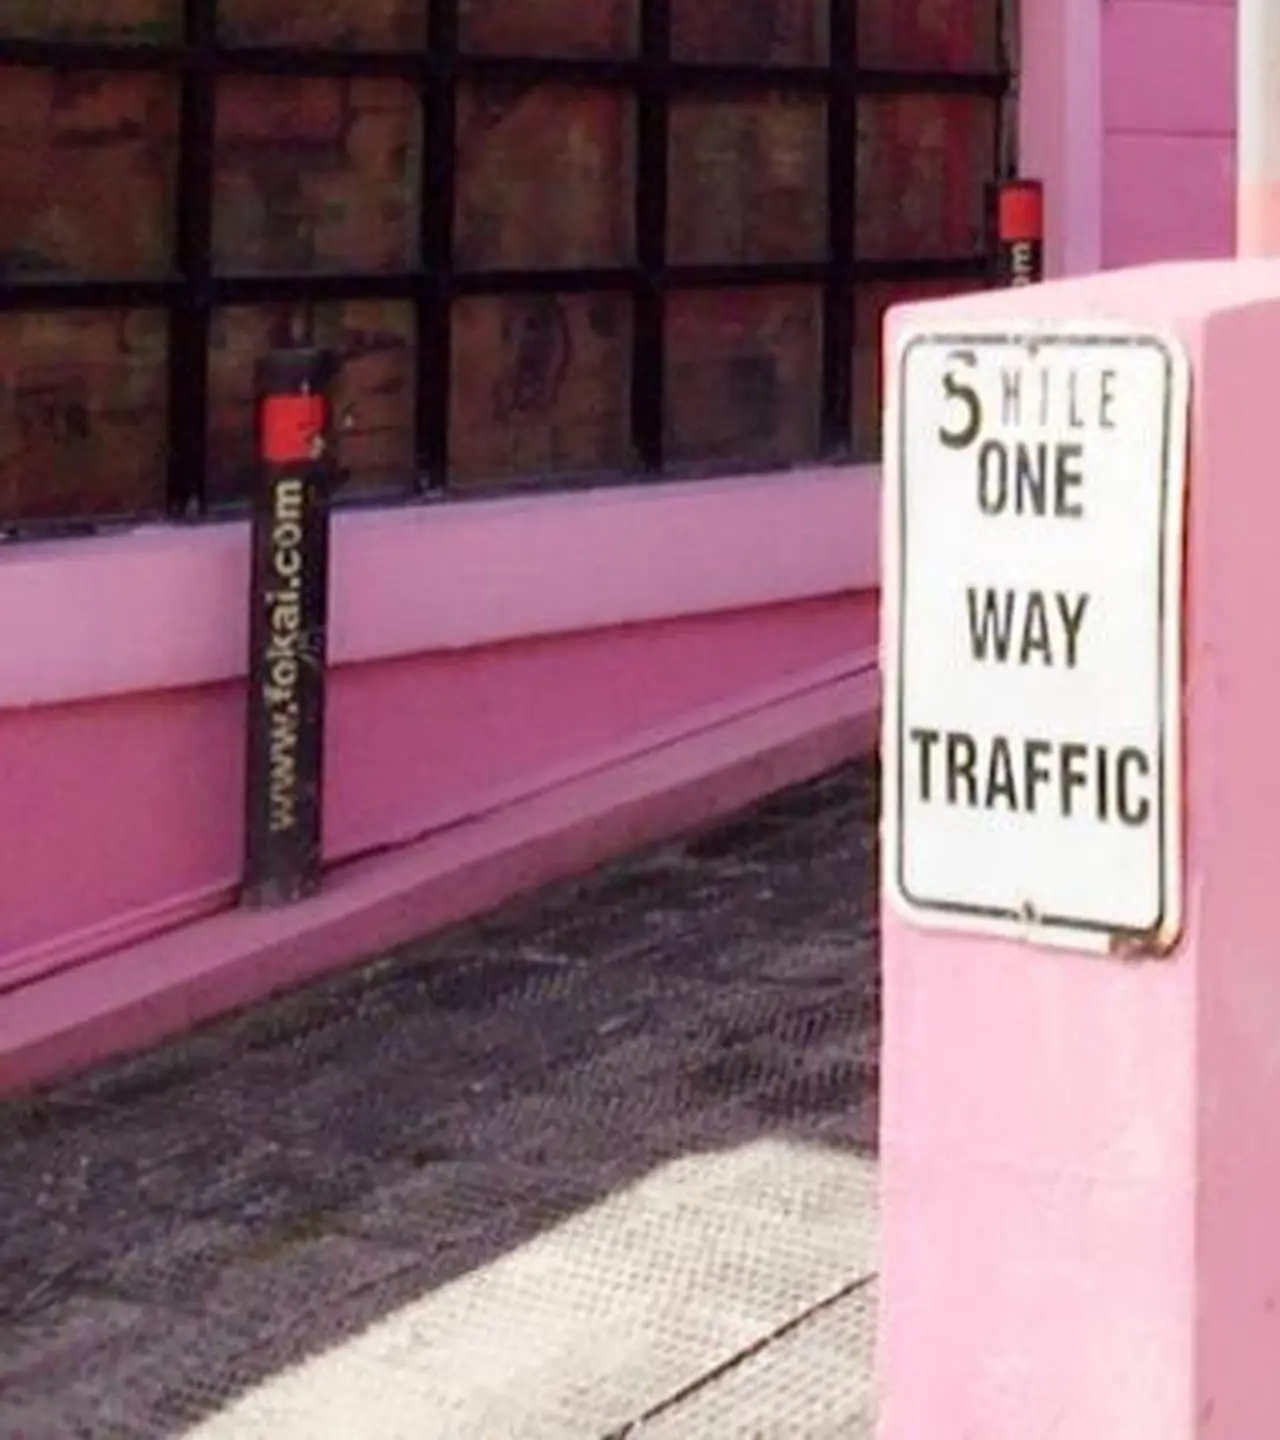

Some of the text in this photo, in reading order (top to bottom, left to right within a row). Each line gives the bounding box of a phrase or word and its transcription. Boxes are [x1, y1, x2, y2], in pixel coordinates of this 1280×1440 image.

[977, 438, 1083, 517] ONE
[264, 478, 303, 831] www.fokai.com
[966, 587, 1089, 668] WAY
[910, 727, 1153, 828] TRAFFIC
